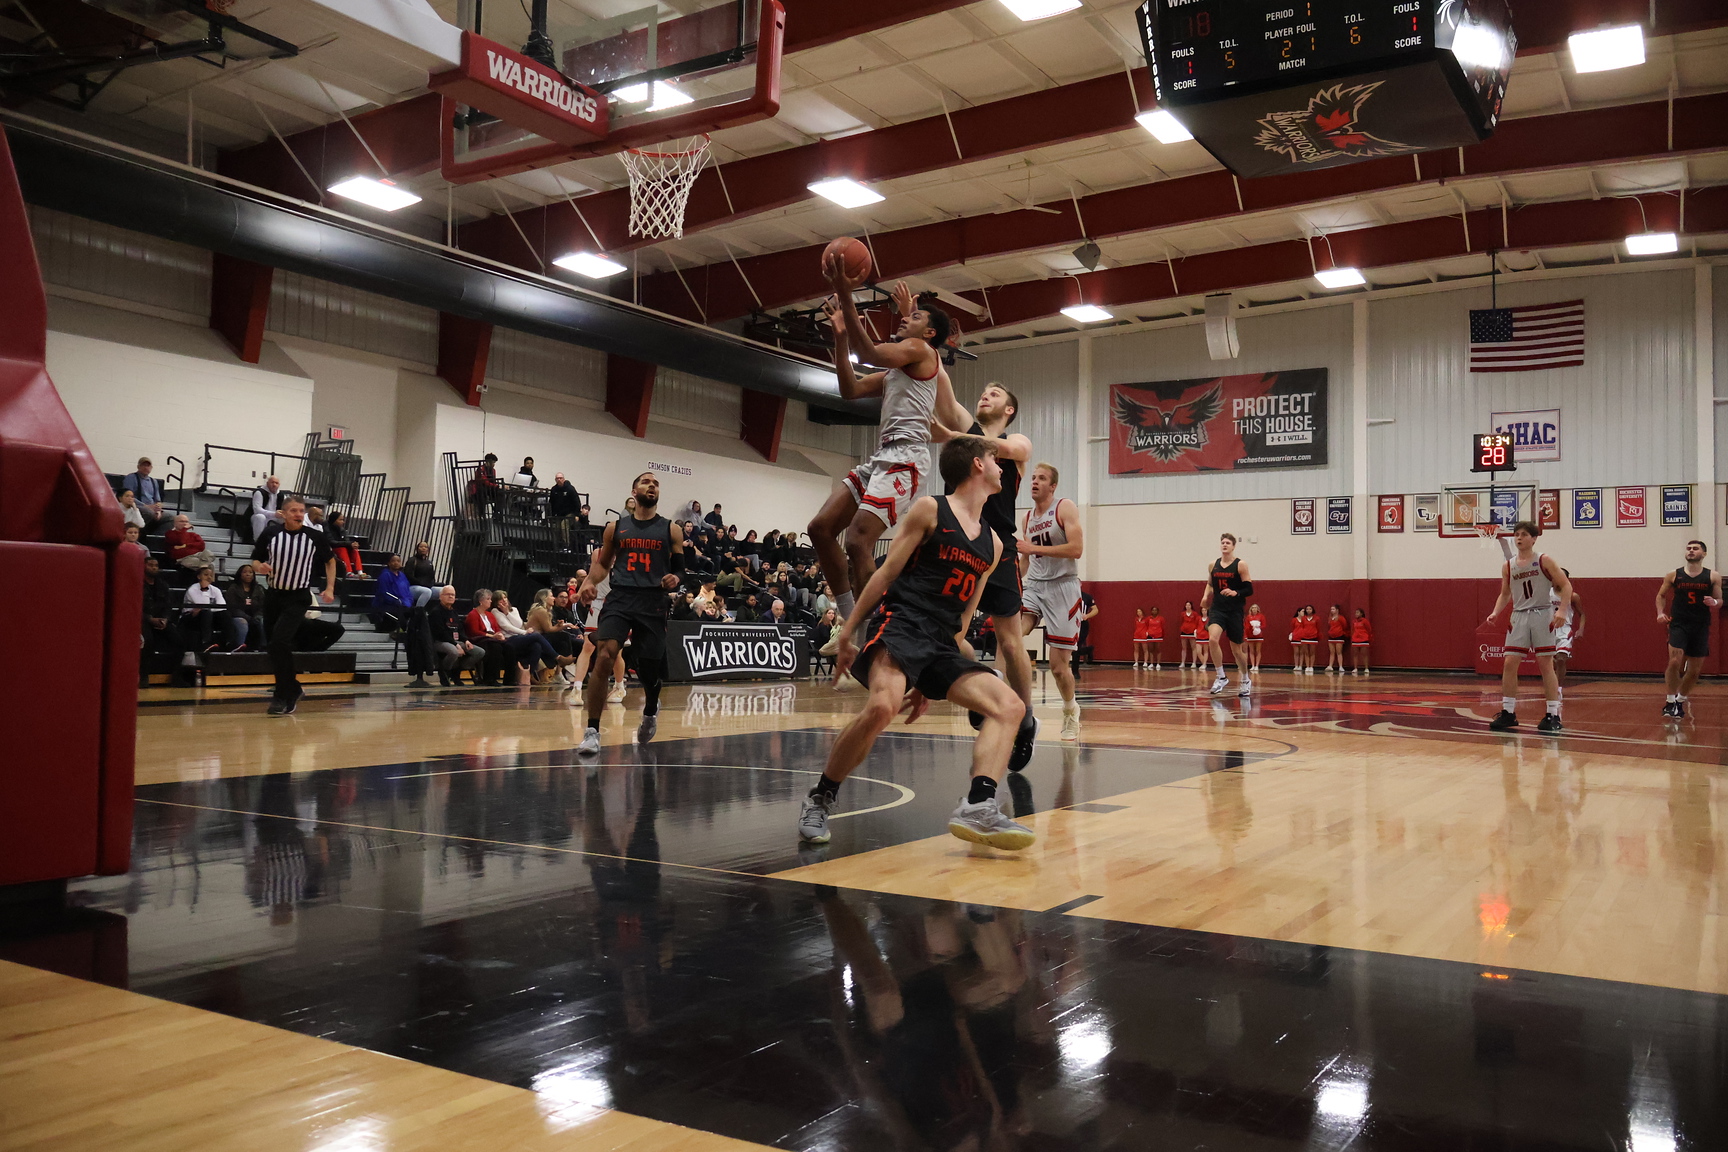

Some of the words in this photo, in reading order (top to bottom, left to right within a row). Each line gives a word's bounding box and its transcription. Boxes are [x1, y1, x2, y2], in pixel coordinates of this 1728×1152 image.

[1266, 8, 1294, 22] PERIOD
[1306, 2, 1311, 16] 1
[1394, 2, 1420, 14] FOULS
[1344, 13, 1365, 24] T.O.L.
[1412, 16, 1417, 31] 1
[1264, 27, 1294, 40] PLAYER
[1296, 22, 1316, 34] FOUL
[1350, 26, 1361, 45] 6
[1219, 39, 1239, 49] T.O.L.
[1282, 40, 1292, 58] 2
[1311, 37, 1315, 50] 1
[1395, 36, 1422, 48] SCORE
[1142, 0, 1162, 101] WARRIORS
[1172, 47, 1194, 59] FOULS
[1225, 51, 1235, 68] 5
[1279, 58, 1306, 71] MATCH
[1188, 61, 1193, 74] 1
[487, 50, 597, 123] WARRIORS
[1173, 79, 1197, 90] SCORE
[1274, 118, 1321, 160] WARRIORS
[1233, 393, 1313, 418] PROTECT
[1232, 418, 1262, 435] THIS
[1266, 415, 1316, 433] HOUSE.
[1136, 434, 1198, 447] WARRIORS
[1481, 436, 1509, 446] 10:34
[1238, 455, 1311, 463] rochesteruwarriors.com
[1482, 447, 1504, 465] 28
[648, 462, 670, 472] CRIMSON
[671, 466, 691, 475] CRAZIES
[1029, 520, 1052, 534] WARRIORS
[620, 538, 662, 550] WARRIORS
[627, 552, 651, 572] 24
[1512, 569, 1539, 580] WARRIORS
[942, 568, 976, 602] 20
[1218, 579, 1228, 589] 15
[1523, 580, 1533, 599] 11
[1688, 592, 1696, 604] 5
[688, 641, 793, 670] WARRIORS
